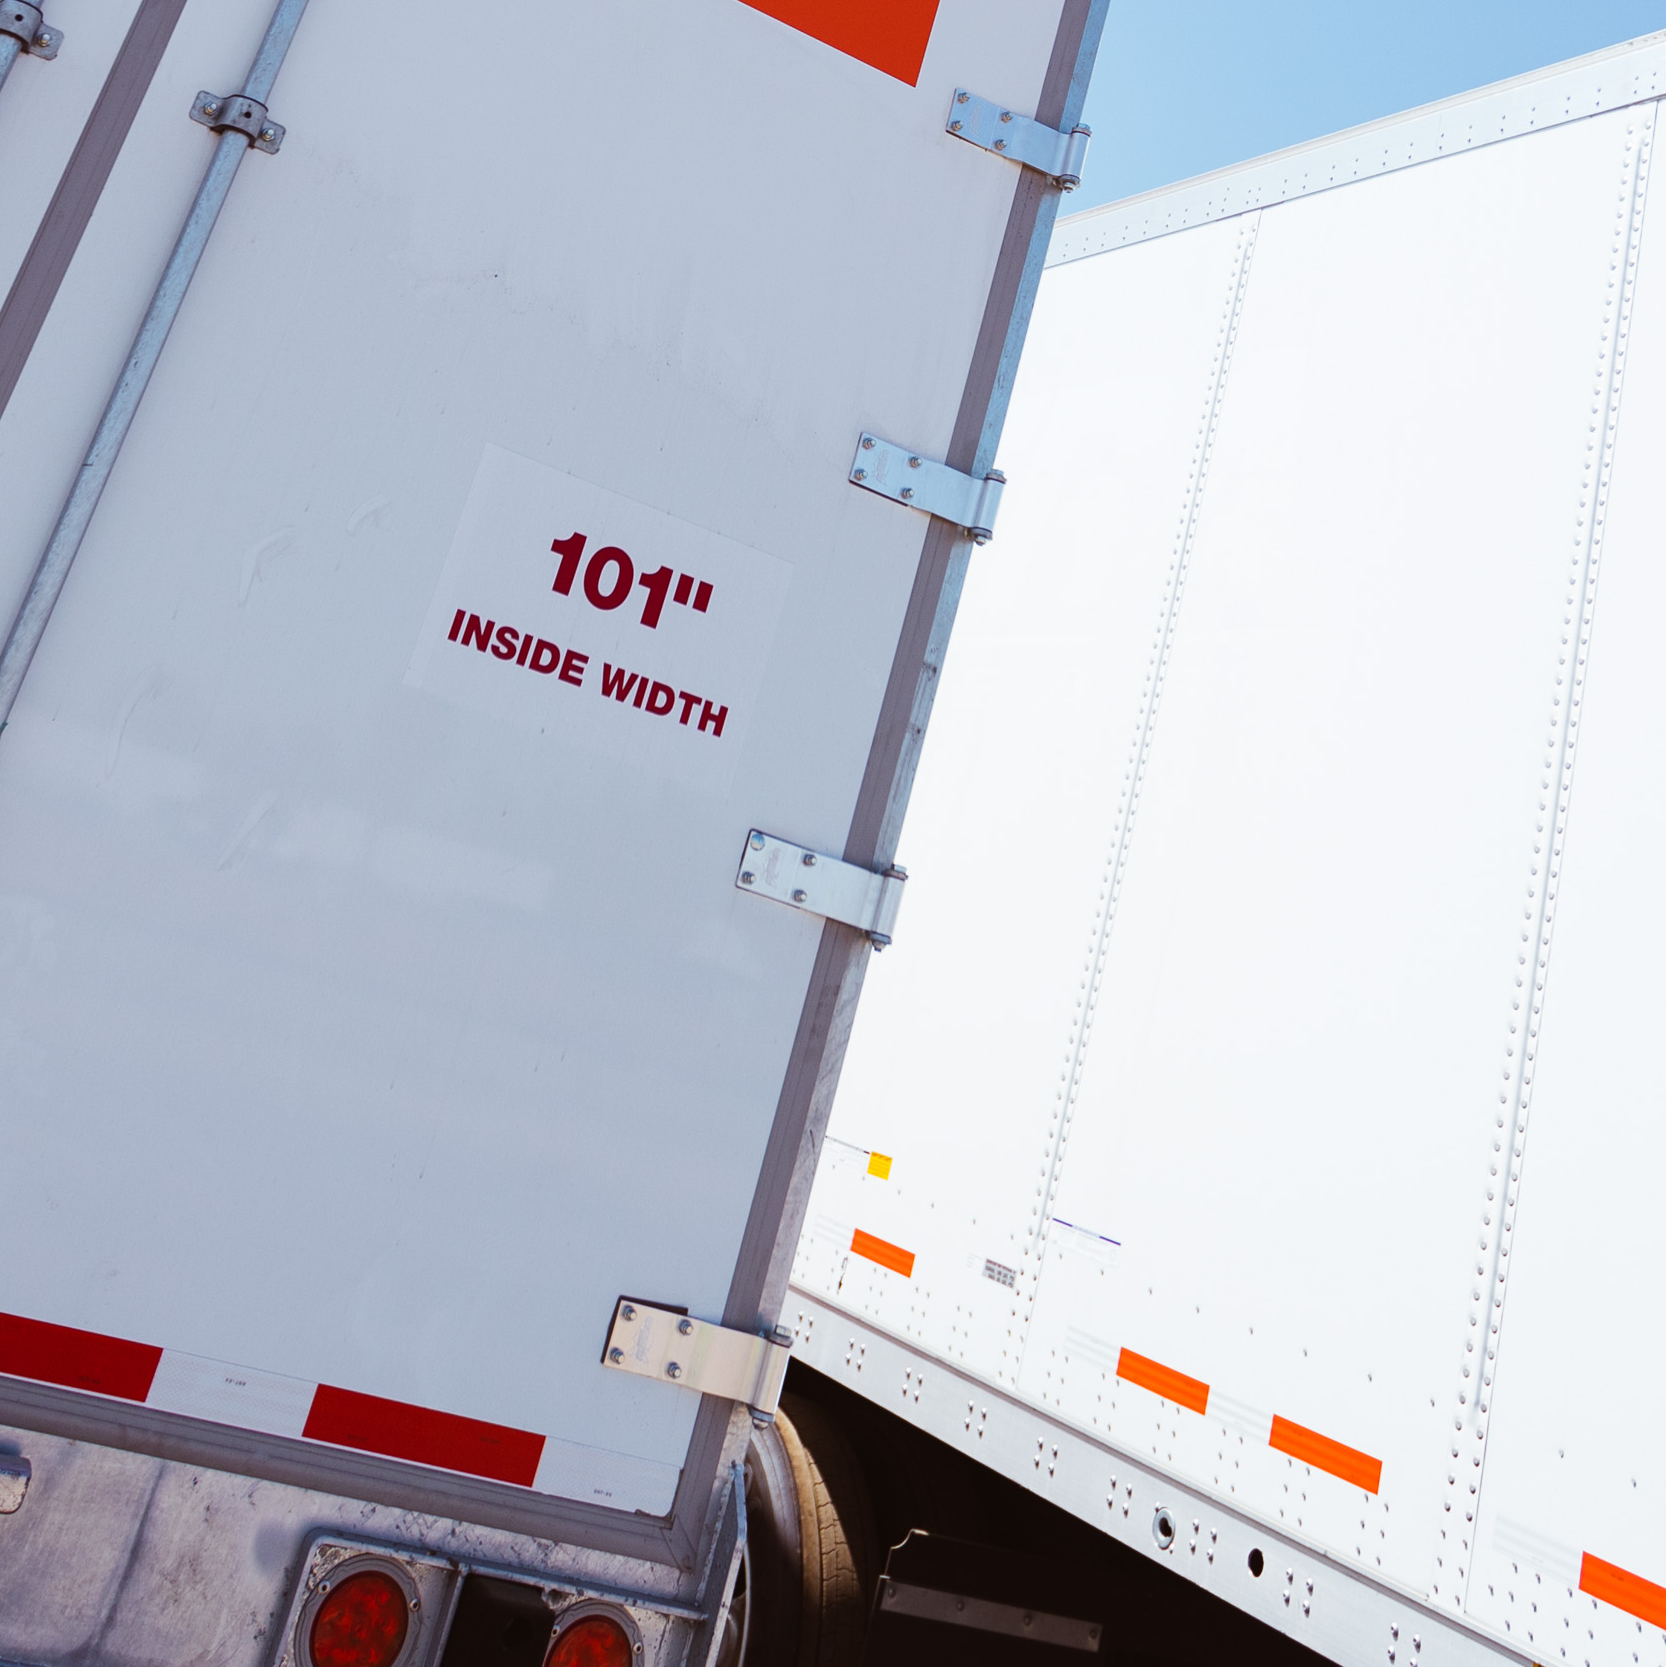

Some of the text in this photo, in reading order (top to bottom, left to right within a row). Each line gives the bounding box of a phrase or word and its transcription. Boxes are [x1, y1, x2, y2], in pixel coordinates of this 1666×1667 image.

[550, 531, 714, 630] 101"
[447, 608, 729, 738] INSIDE WIDTH
